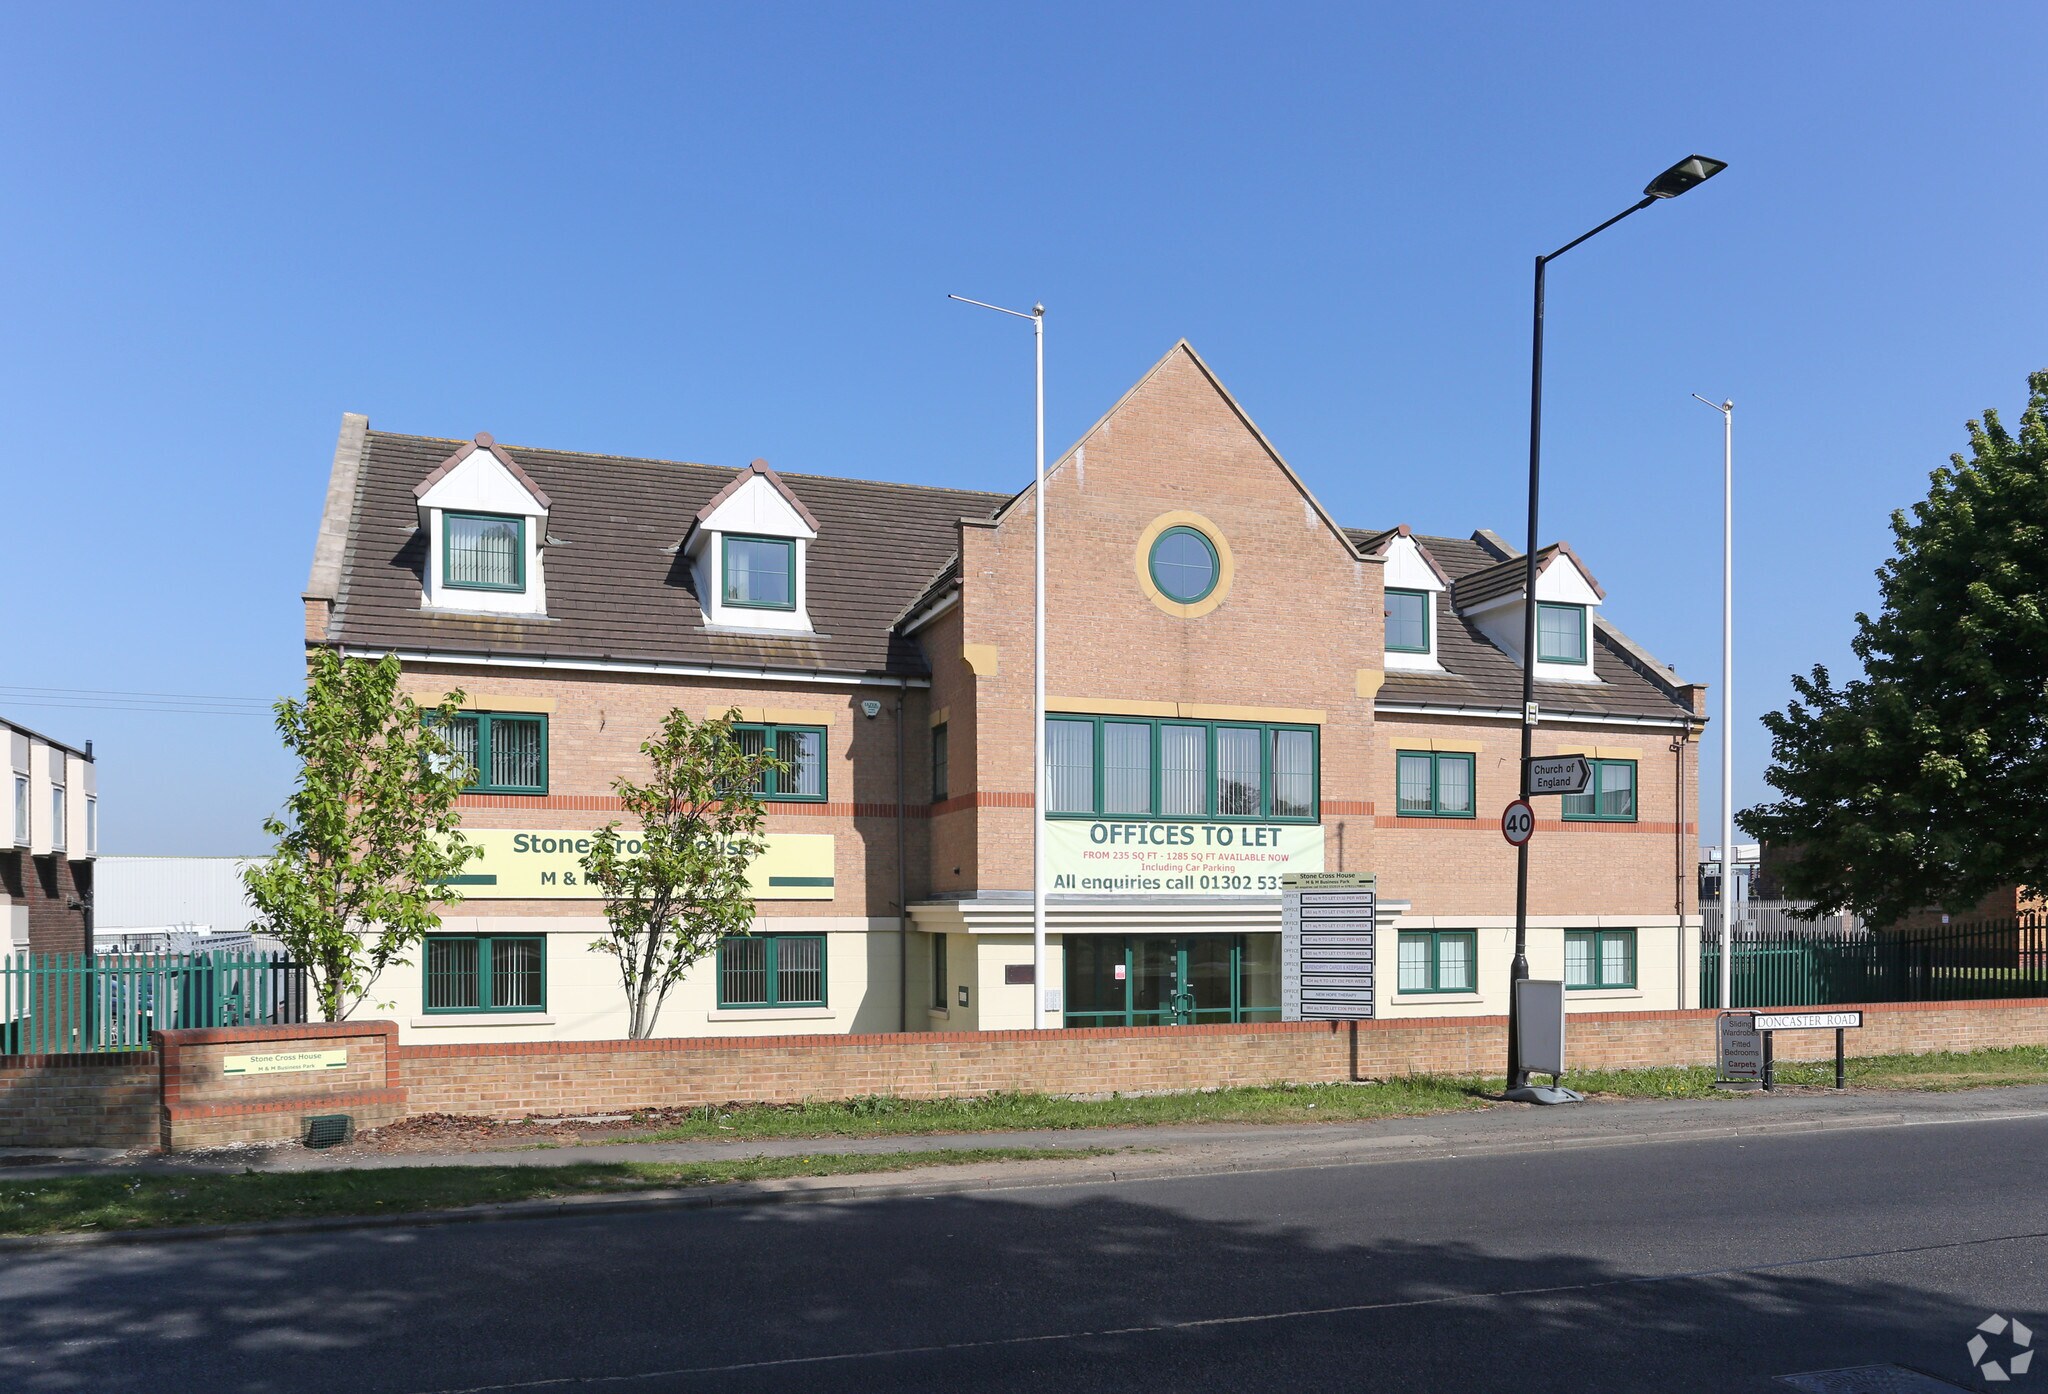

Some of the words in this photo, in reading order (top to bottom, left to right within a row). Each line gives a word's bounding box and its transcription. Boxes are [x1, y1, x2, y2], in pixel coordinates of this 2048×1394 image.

[1534, 765, 1563, 774] Church
[1566, 763, 1575, 772] of
[1538, 776, 1571, 788] England
[1506, 814, 1530, 833] 40
[1090, 824, 1194, 846] OFFICES
[1202, 826, 1234, 846] TO
[1242, 828, 1282, 846] LET
[514, 834, 589, 854] Stone
[1084, 851, 1110, 859] FROM
[1132, 852, 1144, 861] SQ
[1191, 853, 1203, 862] SQ
[1218, 853, 1265, 861] AVAILABLE
[1141, 863, 1182, 872] Including
[1203, 864, 1235, 873] Parking
[541, 872, 556, 886] M
[564, 871, 577, 886] &
[1054, 874, 1075, 889] All
[1082, 875, 1160, 892] enquiries
[1166, 875, 1194, 889] call
[1200, 876, 1252, 890] 01302
[1758, 1016, 1821, 1028] DONCASTER
[1828, 1014, 1857, 1026] ROAD
